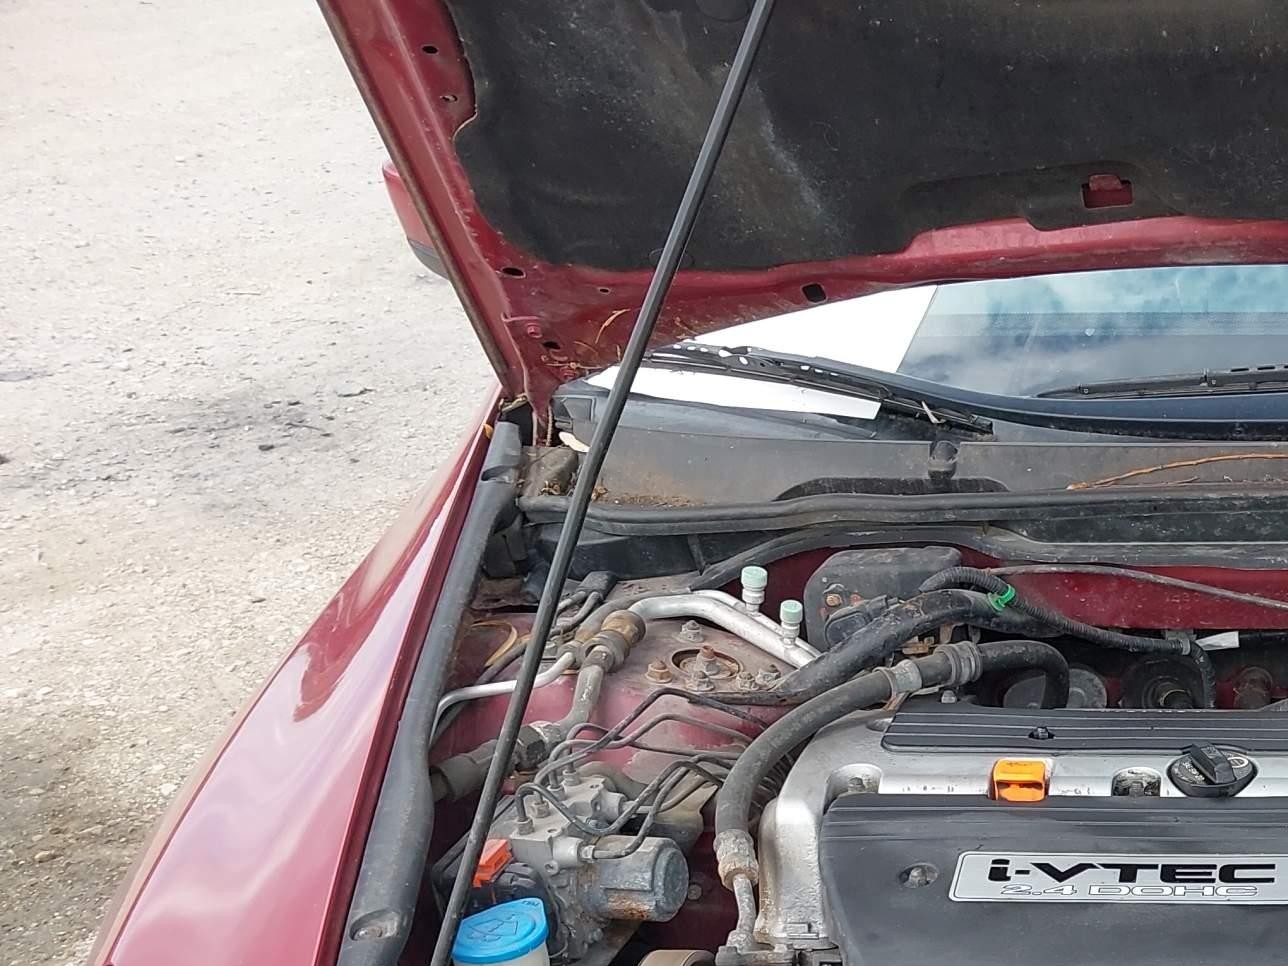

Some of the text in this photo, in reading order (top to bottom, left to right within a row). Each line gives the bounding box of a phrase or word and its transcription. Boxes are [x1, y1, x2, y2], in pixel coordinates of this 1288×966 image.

[988, 859, 1276, 884] i-VTEC
[1001, 884, 1258, 897] 2.4 DOHC
